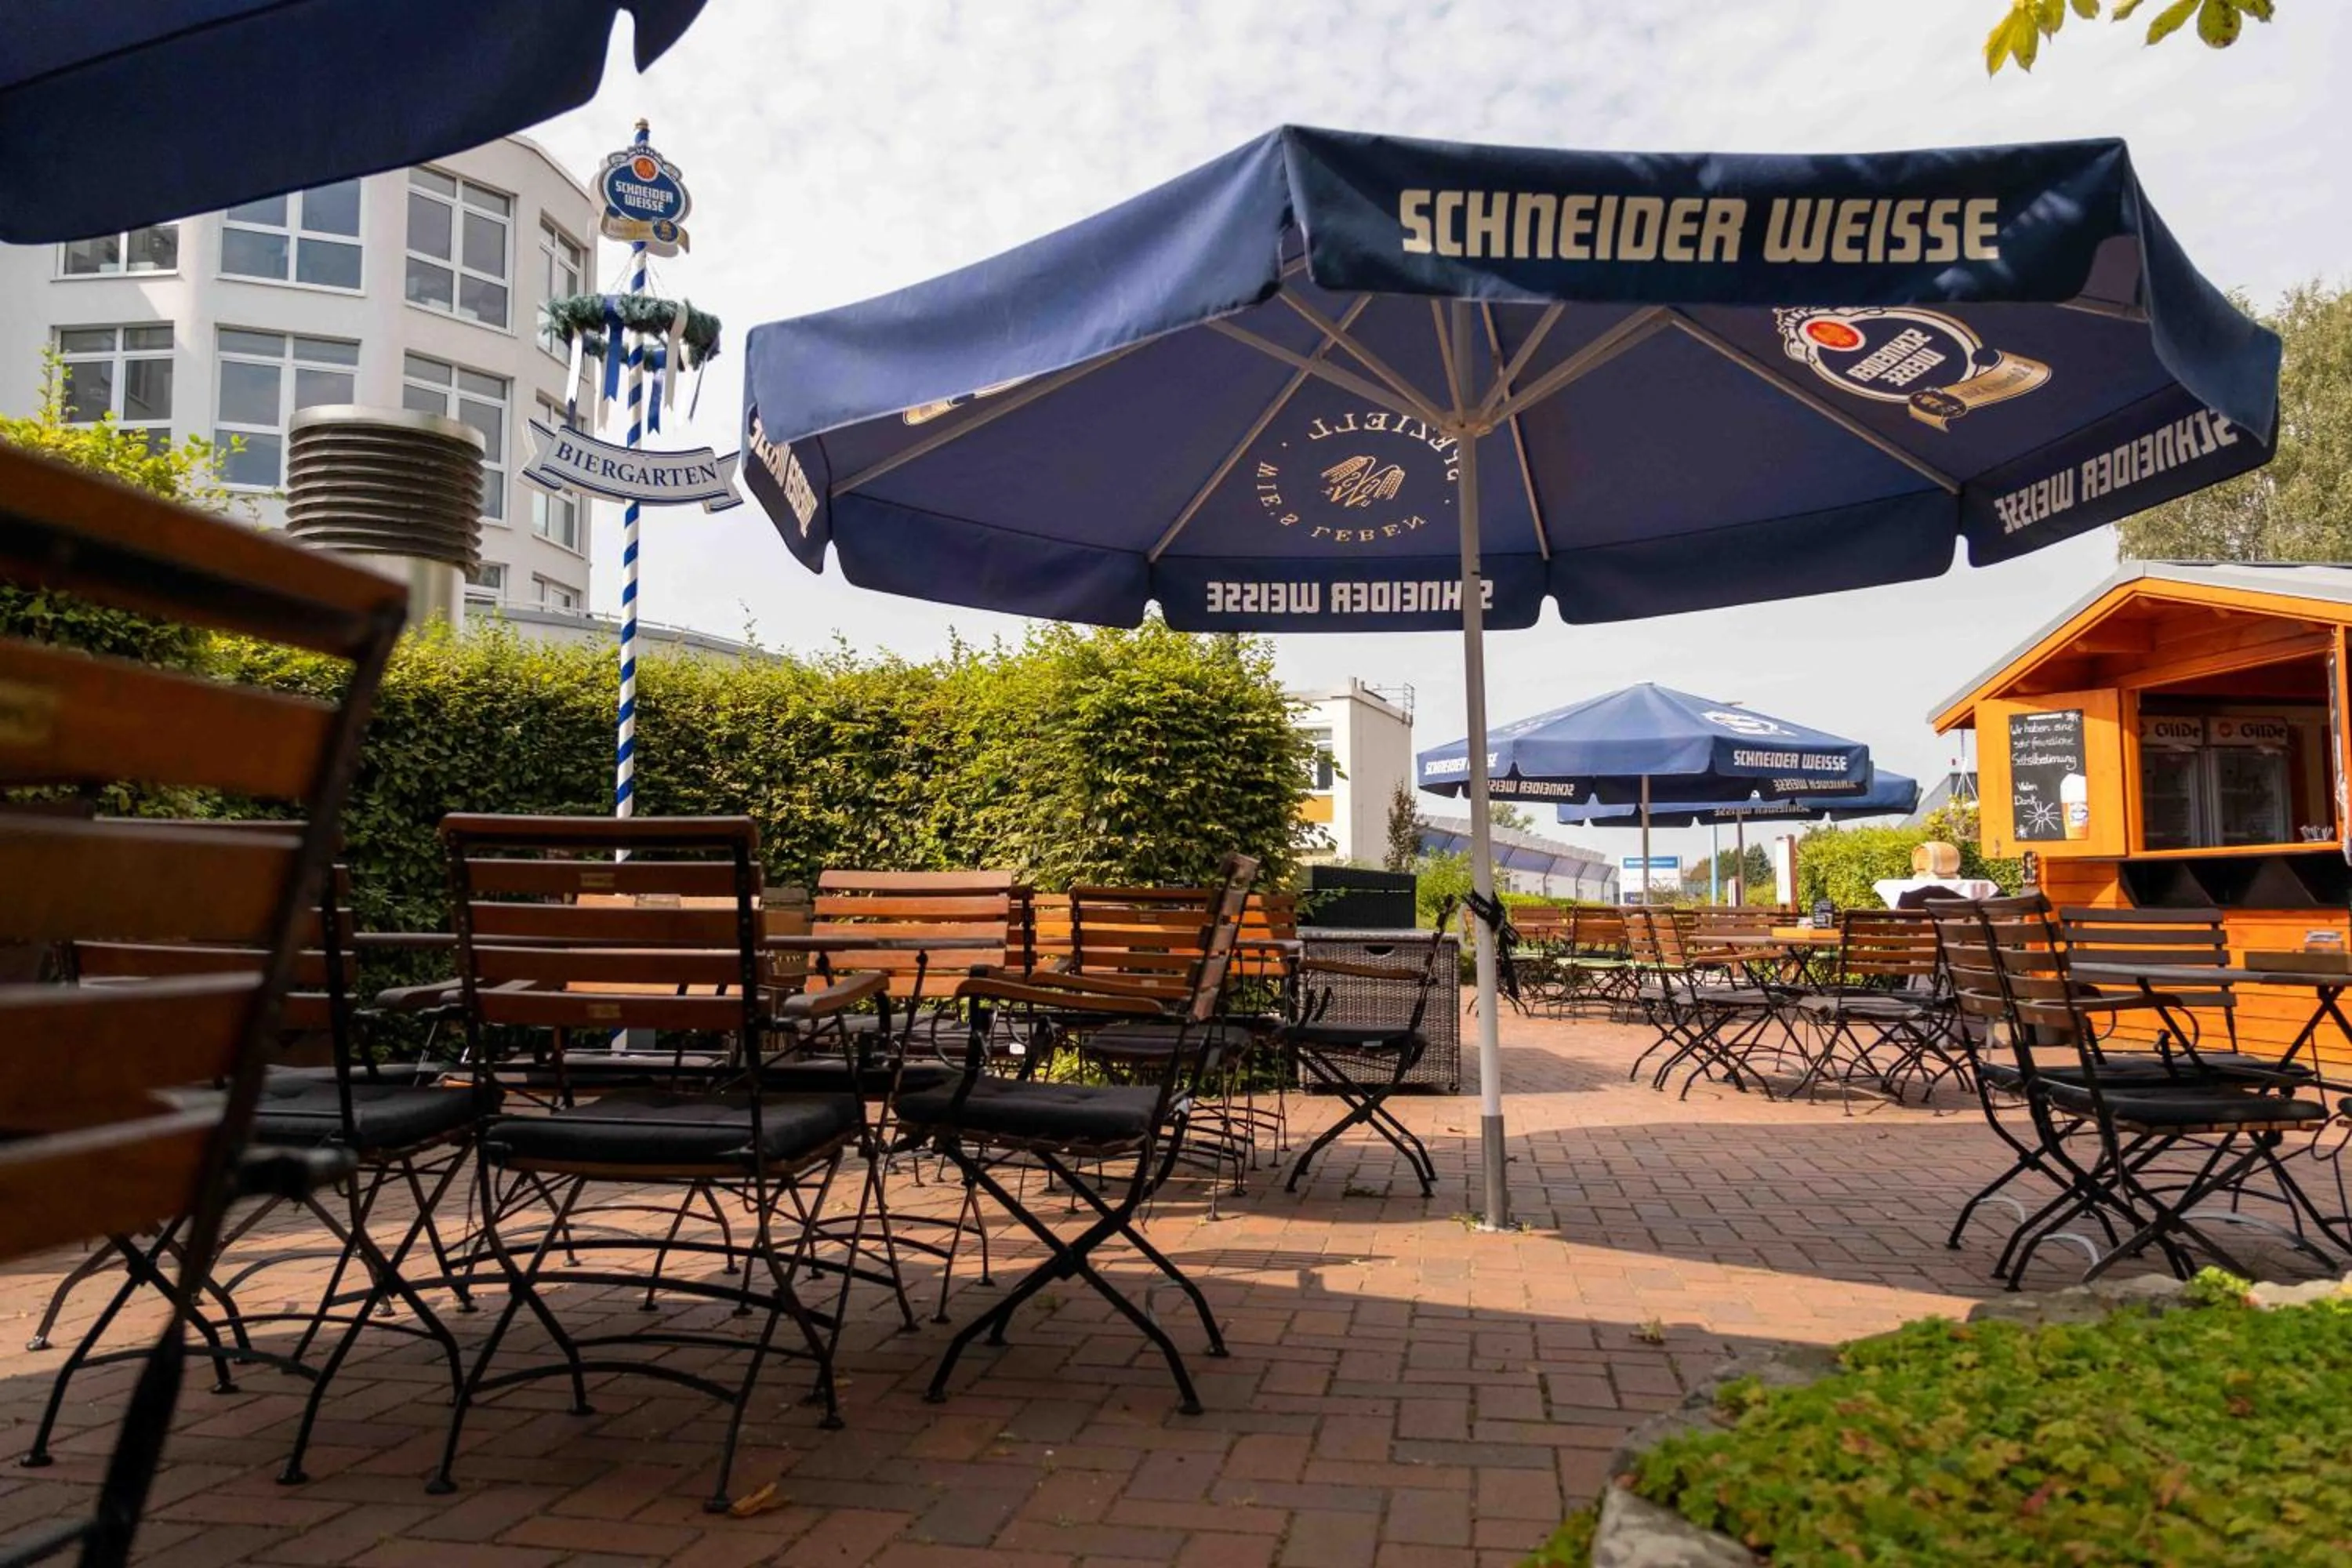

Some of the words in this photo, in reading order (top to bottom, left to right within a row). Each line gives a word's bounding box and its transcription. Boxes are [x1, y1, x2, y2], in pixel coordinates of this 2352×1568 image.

[615, 180, 673, 203] SCHNEIDER
[625, 194, 664, 212] WEISSE
[1399, 188, 1747, 263] SCHNEIDER
[1762, 197, 2000, 264] WEISSE
[554, 440, 717, 488] BIERGARTEN
[2154, 722, 2200, 739] Gilde
[2239, 722, 2286, 739] Gilde
[1733, 749, 1800, 769] SCHNEIDER
[1801, 755, 1848, 771] WEISSE
